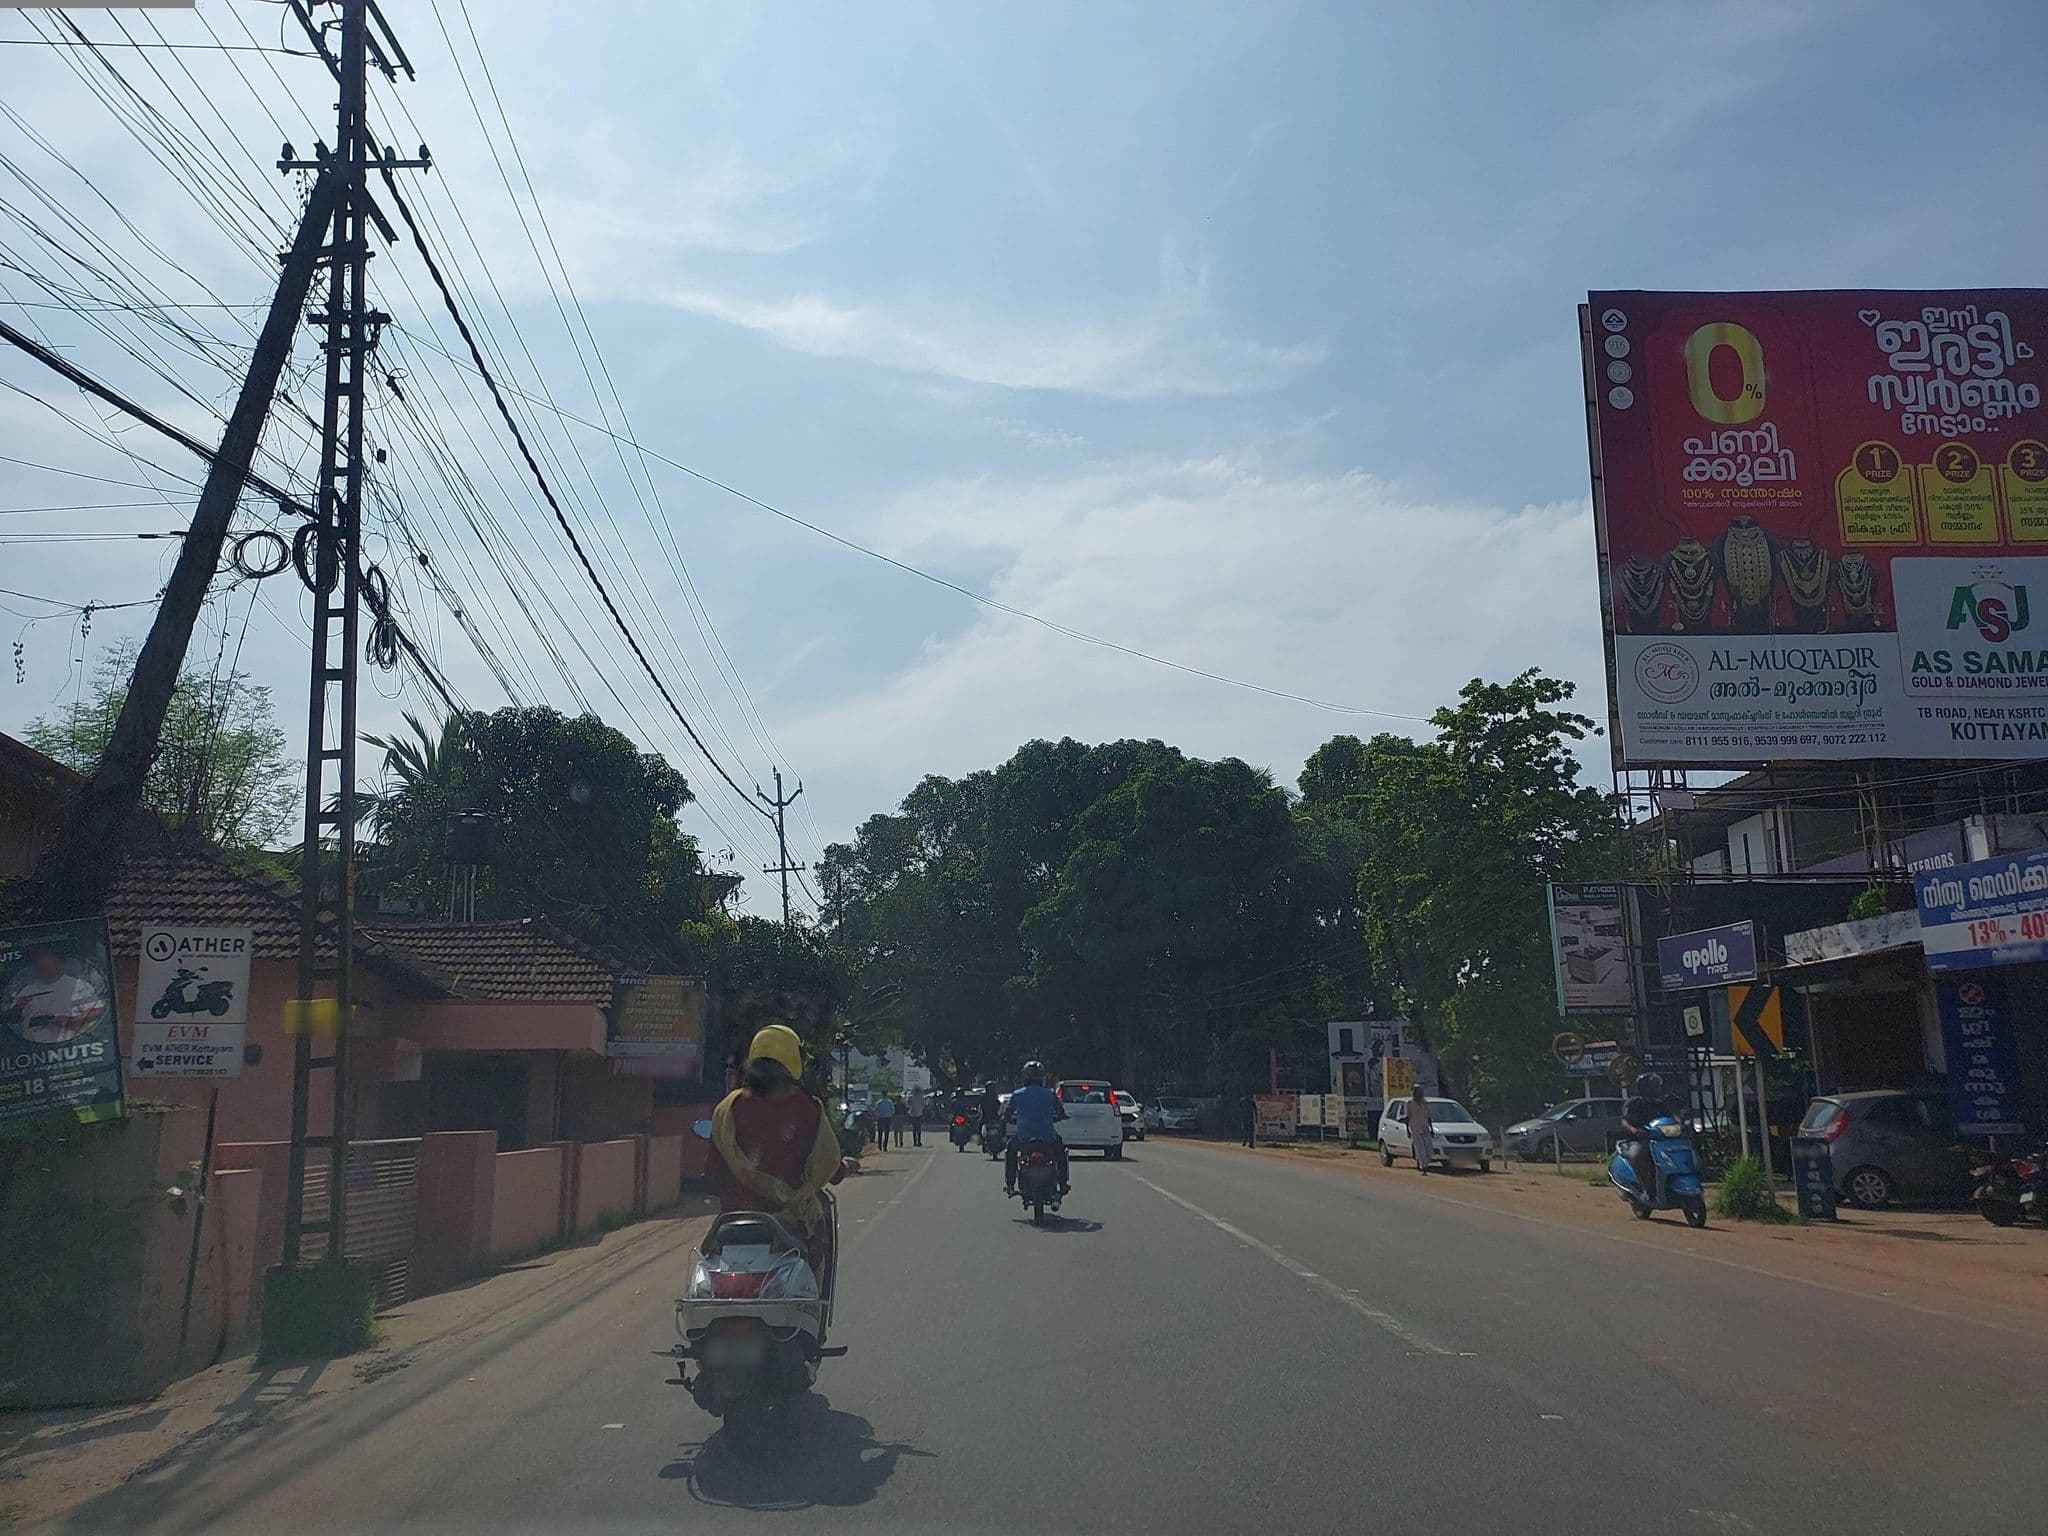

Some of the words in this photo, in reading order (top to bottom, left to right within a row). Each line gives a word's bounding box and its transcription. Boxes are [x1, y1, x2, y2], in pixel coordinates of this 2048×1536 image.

[1921, 305, 1979, 333] ഇനി
[1875, 311, 2015, 378] ഇരട്ടി
[1867, 367, 2040, 419] സ്വർണ്ണം
[1683, 421, 1779, 455] പണി
[1682, 448, 1798, 487] ക്കൂലി
[1865, 470, 1892, 478] PRIZE
[1945, 470, 1972, 478] PRIZE
[1681, 488, 1715, 499] 100%
[1721, 488, 1803, 499] സന്തോഷം
[1707, 647, 1881, 676] AL-MUQTADIR
[1911, 651, 1953, 674] AS
[1912, 676, 1943, 688] GOLD
[1946, 676, 1954, 688] &
[1957, 676, 2012, 688] DIAMOND
[2015, 675, 2048, 688] JEWE
[1917, 707, 1932, 719] TB
[1936, 707, 1971, 720] ROAD,
[1974, 708, 2004, 719] NEAR
[2009, 706, 2045, 719] KSRTC
[1685, 736, 1708, 746] 8111
[1711, 736, 1730, 746] 955
[1731, 736, 1753, 747] 916,
[1755, 735, 1778, 745] 9539
[1780, 735, 1798, 745] 999
[1800, 735, 1821, 746] 697,
[1823, 734, 1846, 745] 9072
[1848, 733, 1866, 744] 222
[1869, 733, 1886, 743] 112
[1903, 852, 1955, 873] NTERIORS
[1923, 878, 1966, 911] നിത്യ
[1969, 862, 2048, 902] മെഡിക്ക
[1967, 918, 2006, 946] 13%
[178, 937, 245, 953] ATHER
[1682, 938, 1728, 975] apollo
[1706, 962, 1729, 975] TYRES
[168, 1026, 210, 1039] EVM
[142, 1043, 162, 1053] EVM
[164, 1044, 190, 1054] ATHER
[191, 1044, 234, 1055] Kottayam
[155, 1054, 215, 1066] SERVICE
[23, 1078, 45, 1097] 18
